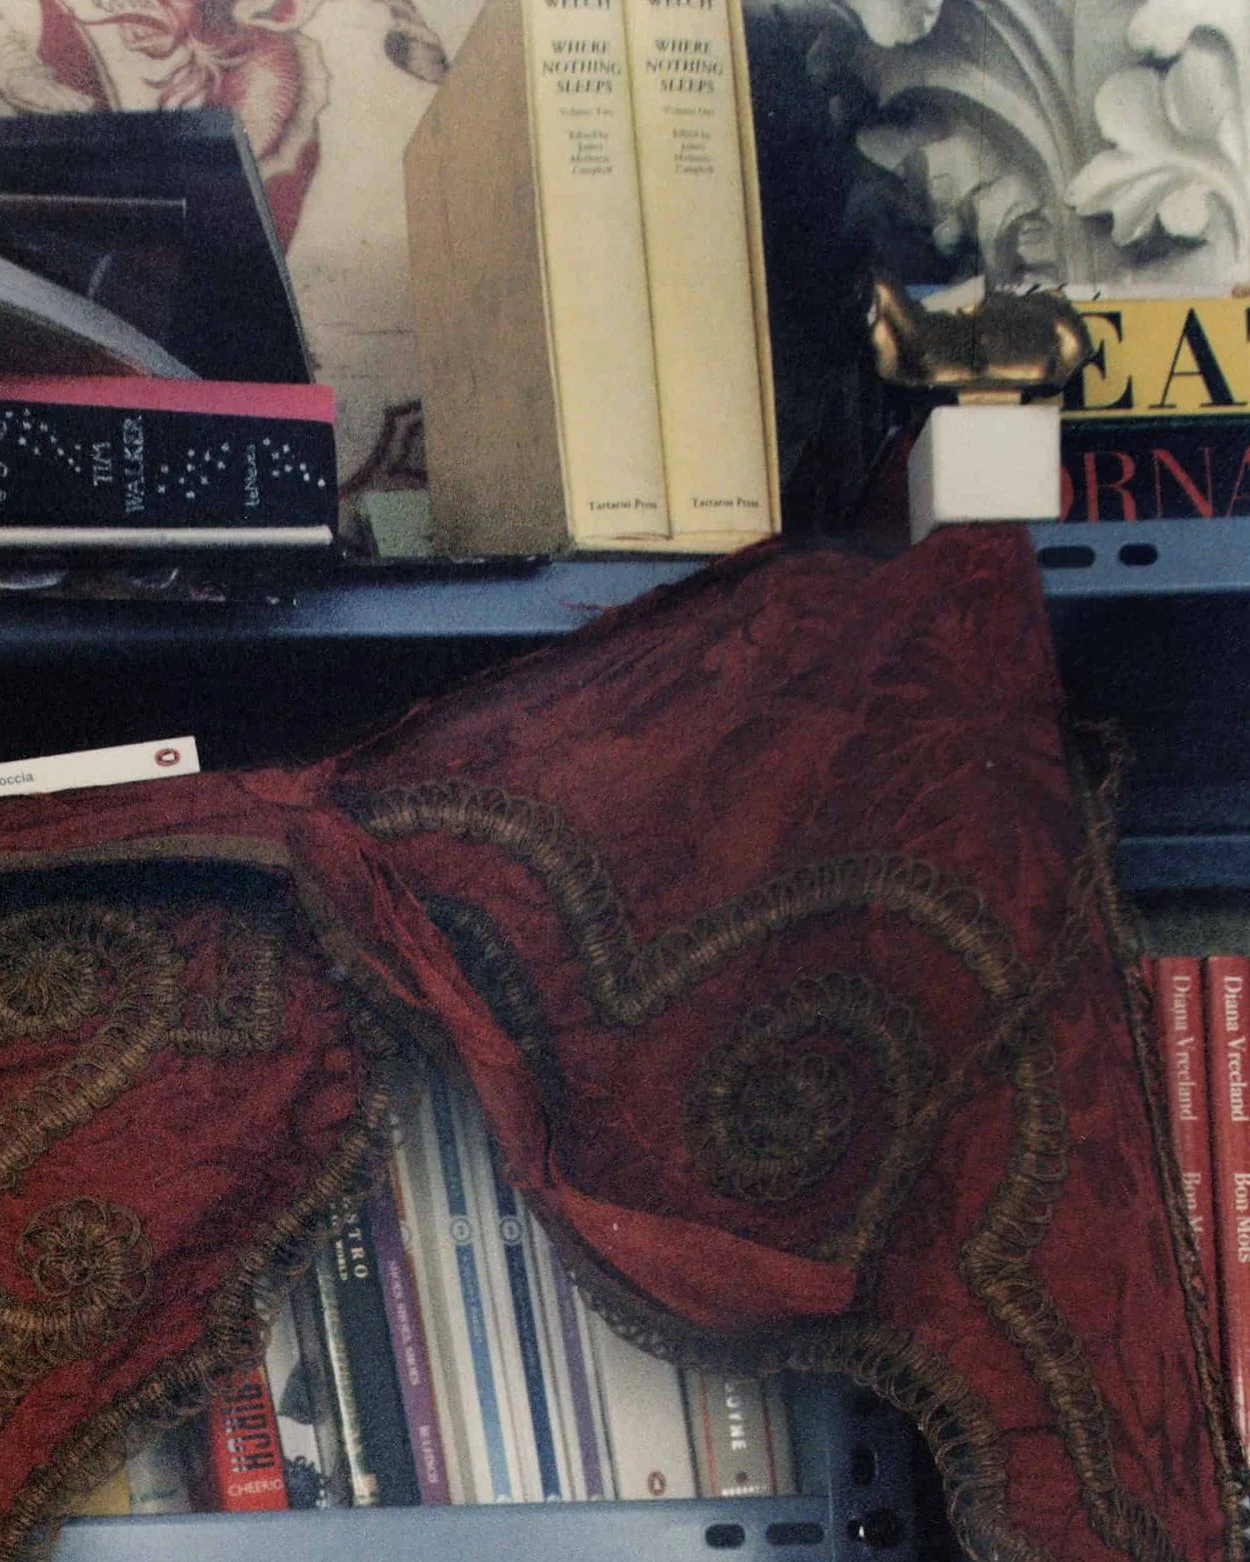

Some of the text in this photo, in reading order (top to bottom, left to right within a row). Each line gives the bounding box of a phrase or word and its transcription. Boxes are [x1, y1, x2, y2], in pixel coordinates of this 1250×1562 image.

[553, 39, 610, 54] WHERE
[655, 39, 711, 54] WHERE
[542, 60, 622, 75] NOTHING
[645, 60, 724, 75] NOTHING
[556, 79, 613, 95] SLEEPS
[660, 77, 715, 94] SLEEPS
[92, 441, 112, 486] TIM
[122, 414, 145, 513] WALKER
[1172, 976, 1199, 1121] Diana Vreeland
[1223, 976, 1249, 1122] Diana Vreeland
